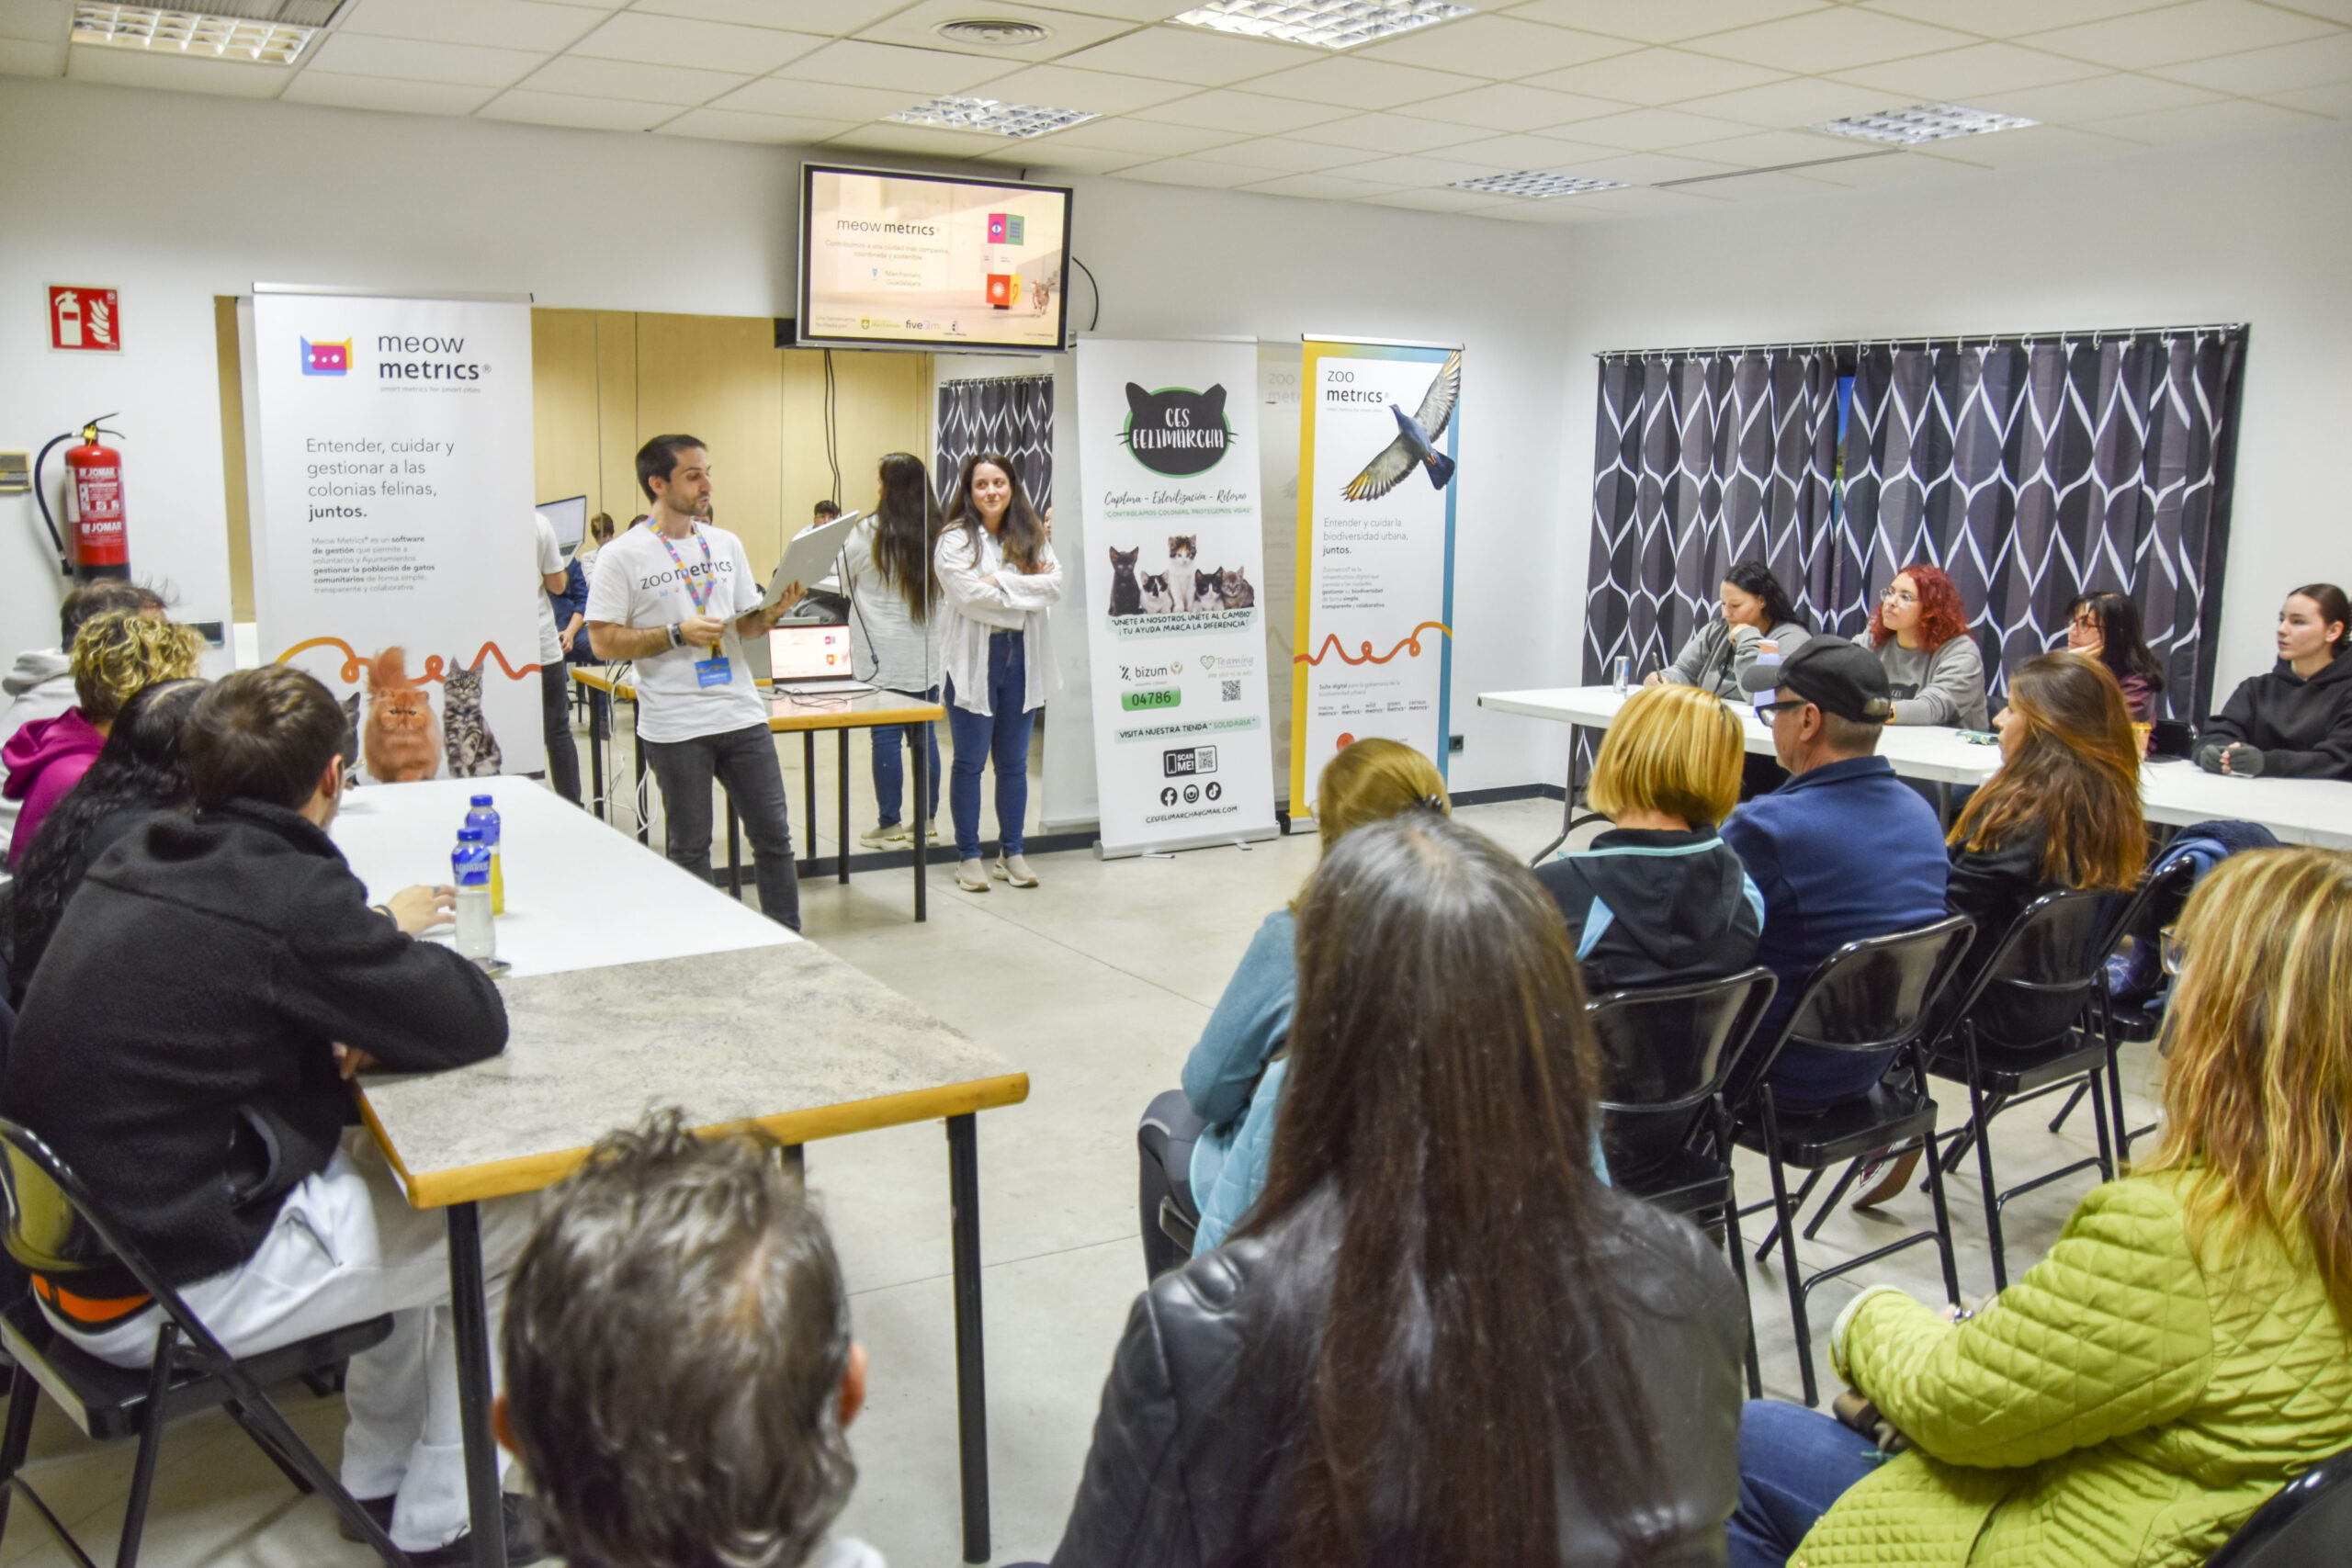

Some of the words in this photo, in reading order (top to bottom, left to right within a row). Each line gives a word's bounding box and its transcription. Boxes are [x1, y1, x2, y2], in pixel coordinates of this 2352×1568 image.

[837, 220, 882, 232] meow
[378, 335, 465, 354] meow
[1327, 370, 1355, 383] zoo
[1165, 408, 1191, 428] CES
[1132, 428, 1226, 449] FELIMARCHA
[306, 437, 386, 455] Entender,
[390, 437, 441, 453] cuidar
[445, 442, 455, 457] y
[88, 468, 116, 477] JOMAR
[307, 460, 385, 479] gestionar
[390, 464, 398, 474] a
[404, 459, 425, 474] las
[308, 481, 377, 497] colonias
[380, 480, 437, 498] felinas,
[1104, 491, 1142, 508] Captura
[1152, 488, 1207, 506] Esterilización
[1216, 489, 1248, 504] Retorno
[309, 504, 368, 523] juntos.
[91, 521, 122, 533] JOMAR
[1324, 517, 1361, 527] Entender
[1363, 520, 1368, 529] y
[1370, 518, 1395, 527] cuidar
[1395, 518, 1402, 527] la
[1323, 532, 1379, 541] biodiversidad
[1381, 532, 1408, 541] urbana,
[324, 547, 355, 556] gestión
[1322, 547, 1352, 558] juntos.
[362, 556, 416, 564] Ayuntamientos
[313, 566, 350, 576] gestionar
[361, 565, 400, 574] población
[413, 564, 435, 573] gatos
[313, 576, 365, 584] comunitarios
[378, 574, 399, 582] forma
[640, 571, 673, 590] zoo
[314, 585, 362, 594] transparente
[1135, 626, 1160, 634] AYUDA
[1163, 624, 1191, 632] MARCA
[1216, 654, 1254, 668] Teaming
[1135, 666, 1168, 678] bizum
[1332, 682, 1348, 691] digital
[1132, 691, 1171, 706] 04786
[1119, 729, 1145, 739] VISITA
[1145, 727, 1182, 737] NUESTRA
[1182, 723, 1208, 733] TIENDA
[1177, 753, 1193, 761] SCAN
[1177, 761, 1194, 773] ME!
